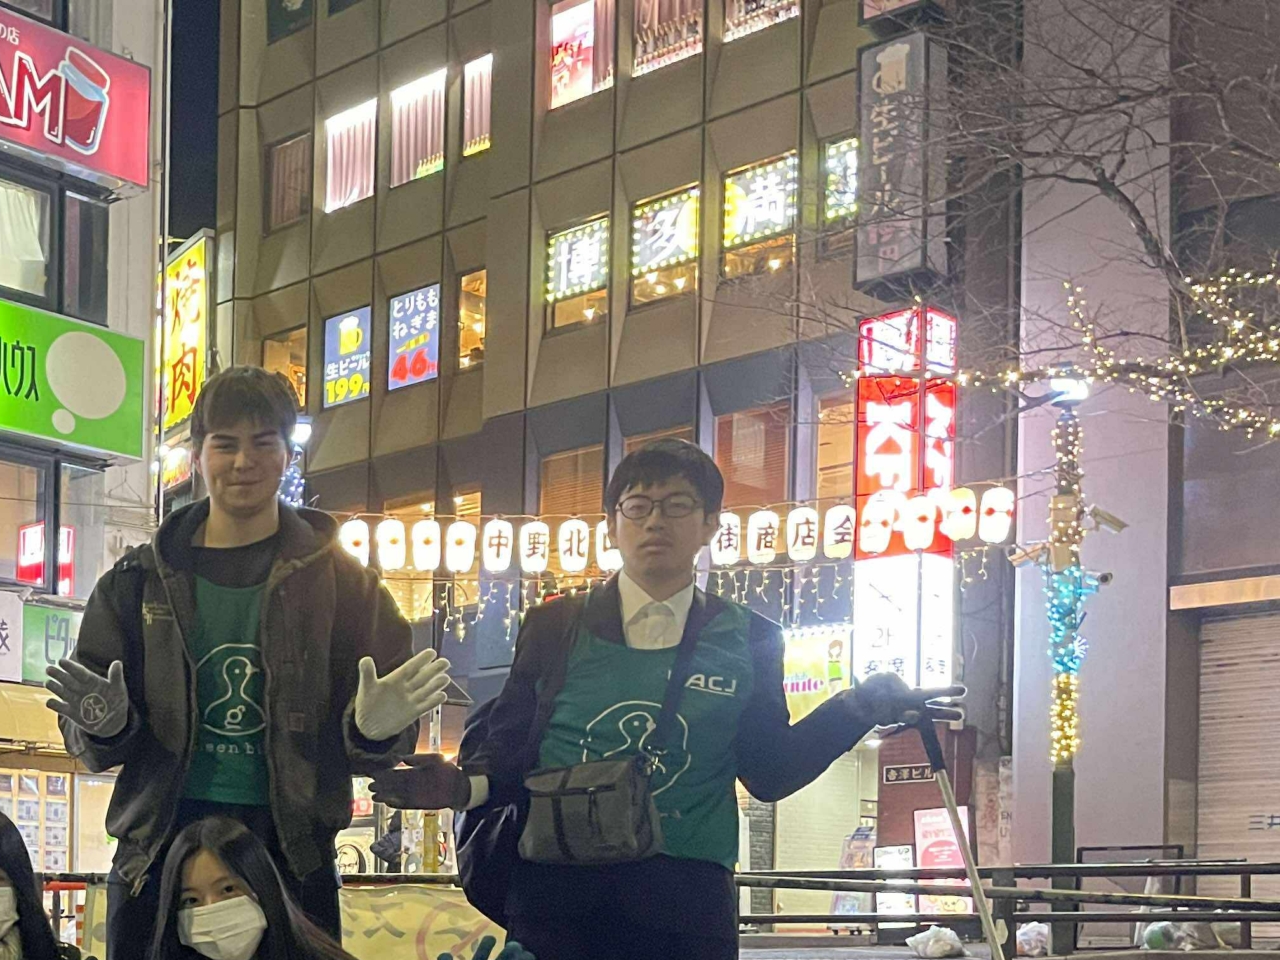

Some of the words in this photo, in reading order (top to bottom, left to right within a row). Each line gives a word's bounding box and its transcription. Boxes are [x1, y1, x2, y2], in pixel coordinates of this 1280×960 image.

[392, 288, 439, 318] とりもも
[170, 258, 201, 415] 焼肉
[392, 309, 438, 340] ねぎま
[325, 355, 371, 380] 生ビール
[716, 514, 853, 551] 街商店会
